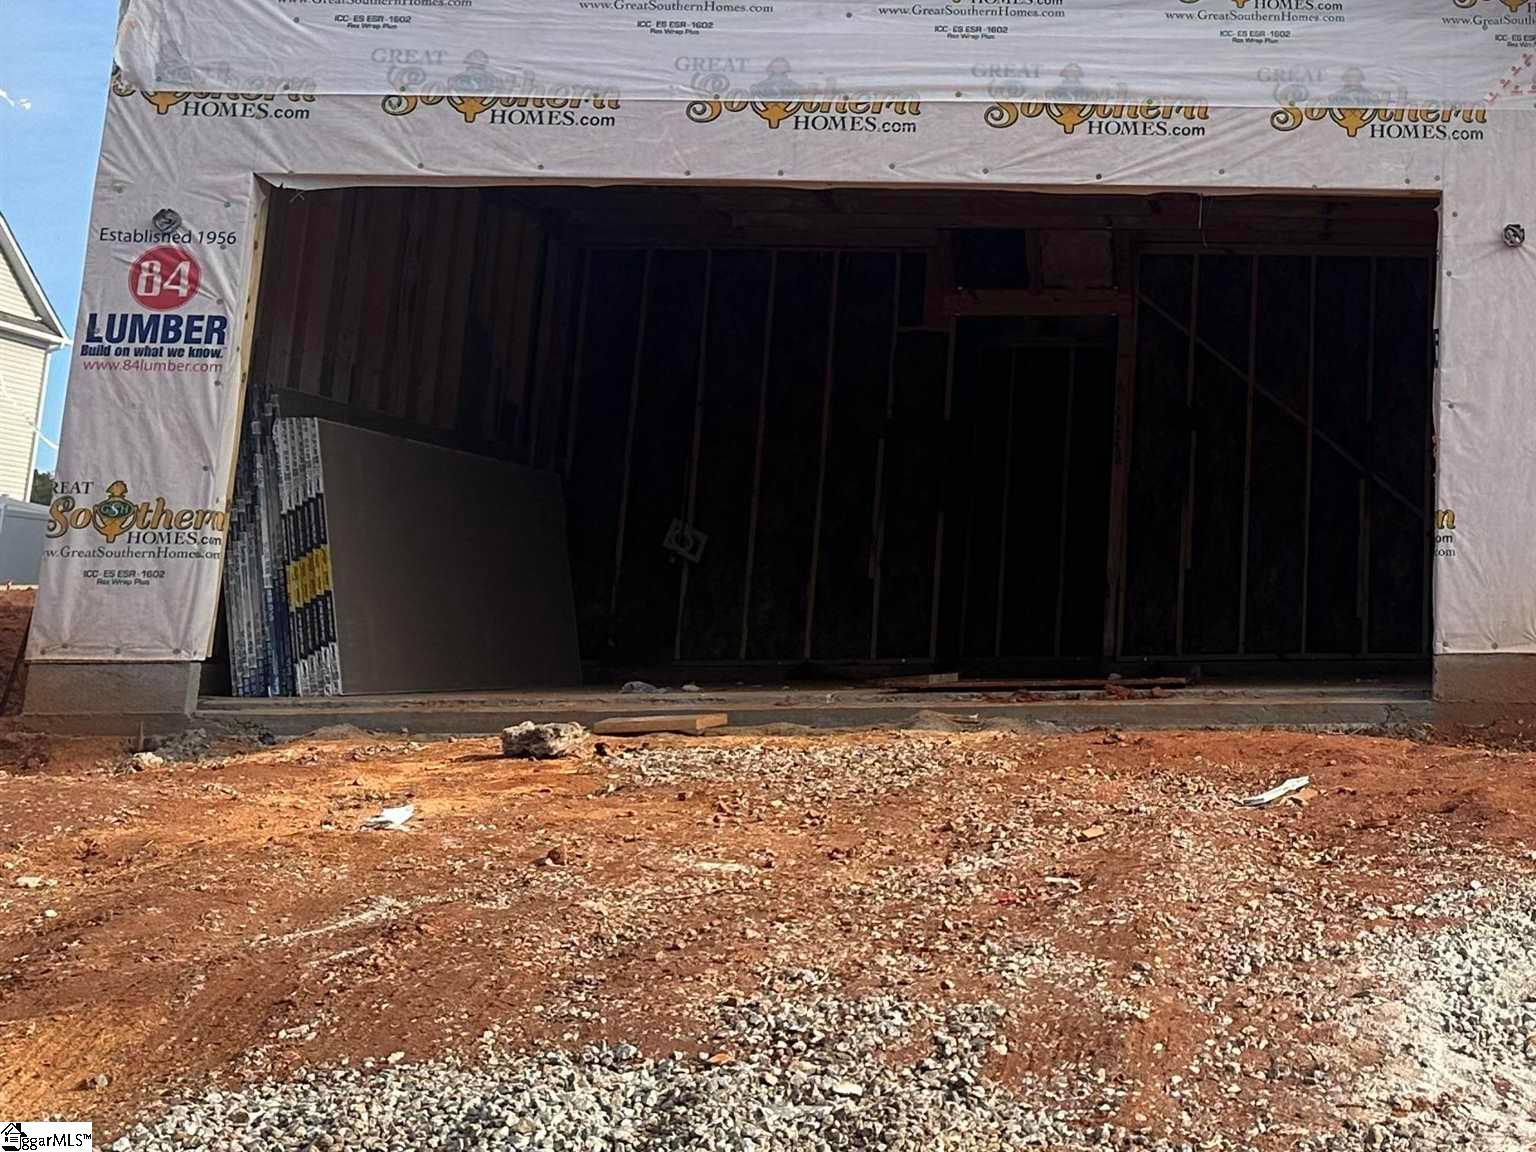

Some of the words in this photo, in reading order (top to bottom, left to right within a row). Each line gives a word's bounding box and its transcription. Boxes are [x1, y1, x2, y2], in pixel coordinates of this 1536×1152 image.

[579, 0, 774, 13] www.GreatSouthernHomes.com
[878, 4, 1065, 18] www.GreatSouthernHomes.com
[1165, 9, 1345, 22] www.GreatSouthernHomes.com
[371, 48, 446, 64] GREAT
[675, 57, 750, 71] GREAT
[182, 100, 310, 119] HOMES.com
[489, 109, 616, 126] HOMES.com
[793, 115, 917, 133] HOMES.com
[1087, 120, 1205, 136] HOMES.com
[1369, 123, 1484, 141] HOMES.com
[100, 228, 192, 245] Established
[198, 231, 237, 245] 1956
[136, 260, 191, 297] 84
[85, 313, 228, 345] LUMBER
[80, 345, 110, 357] Build
[115, 347, 130, 357] on
[134, 345, 163, 358] what
[167, 348, 185, 358] we
[188, 346, 223, 359] know.
[83, 359, 223, 373] www.84lumber.com
[51, 481, 95, 495] REAT
